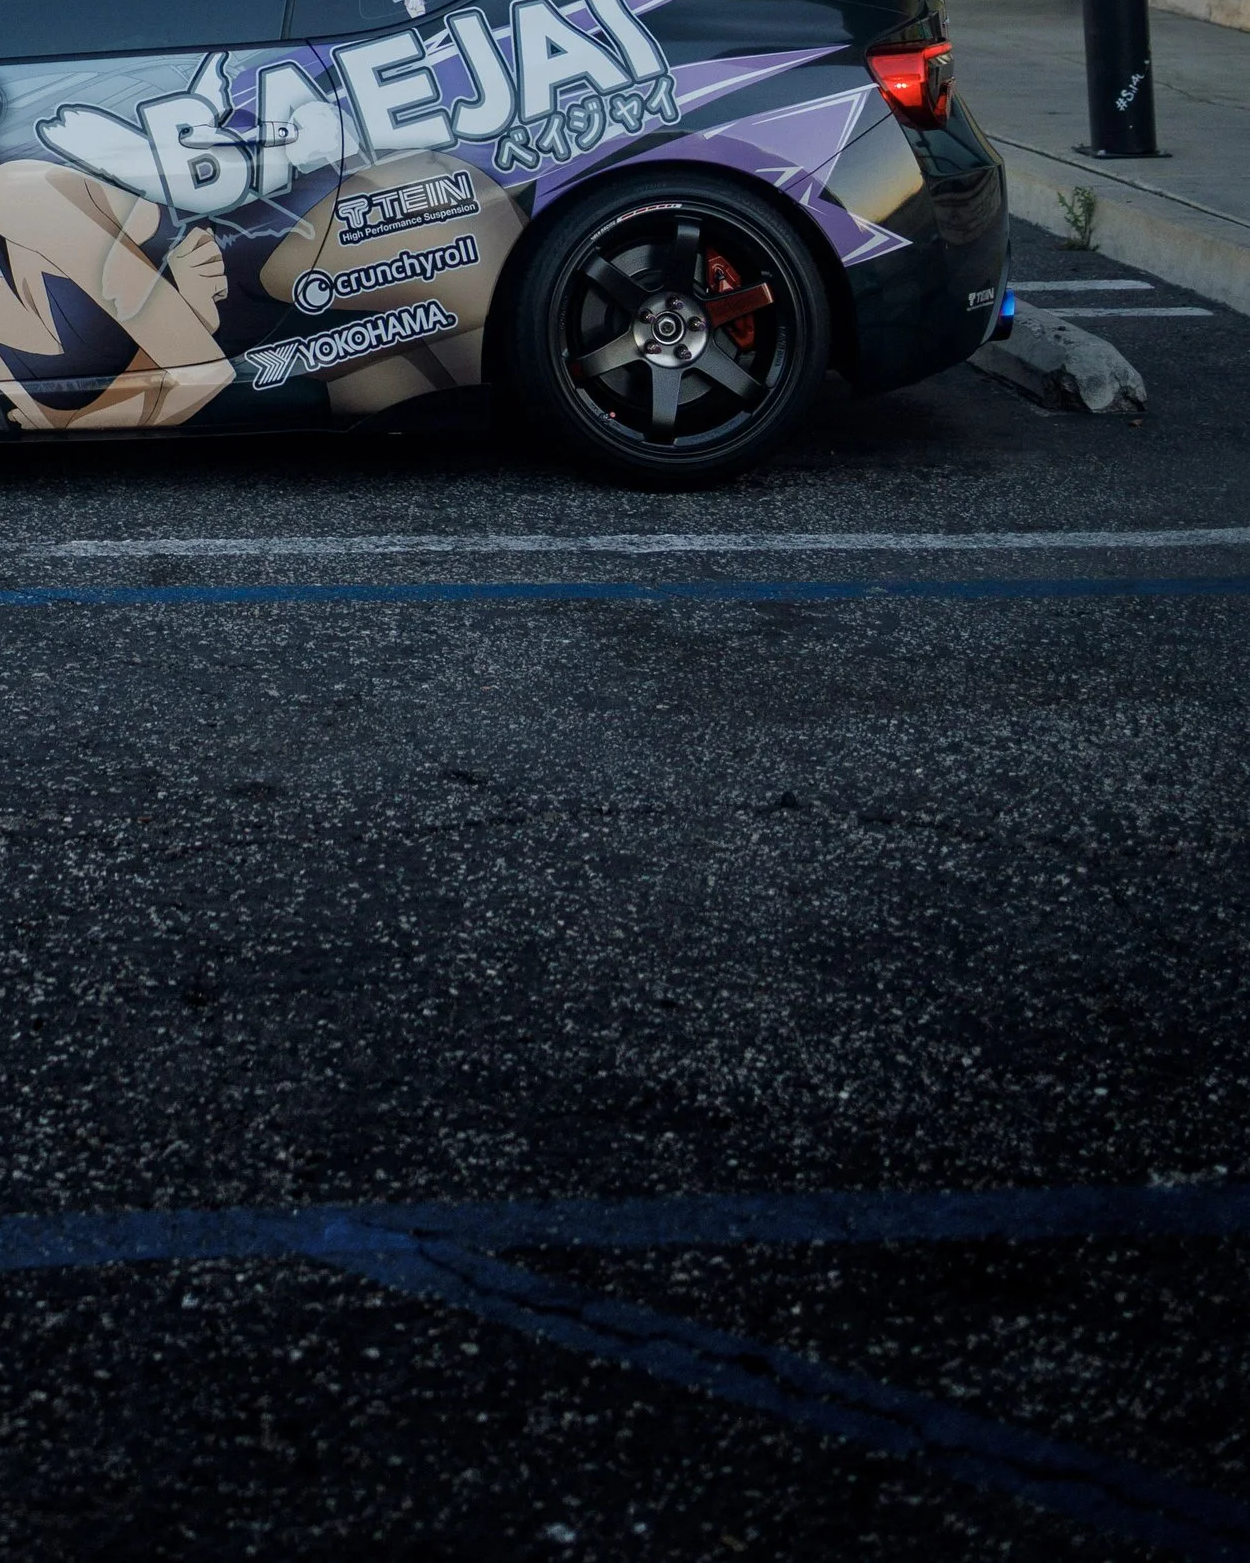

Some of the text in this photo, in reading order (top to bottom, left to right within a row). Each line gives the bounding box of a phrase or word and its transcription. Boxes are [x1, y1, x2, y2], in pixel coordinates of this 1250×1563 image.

[498, 78, 676, 168] ベイジャイ
[342, 202, 477, 243] High Performance Suspension
[336, 238, 476, 294] crunchyroll
[300, 302, 450, 366] YOKOHAMA
